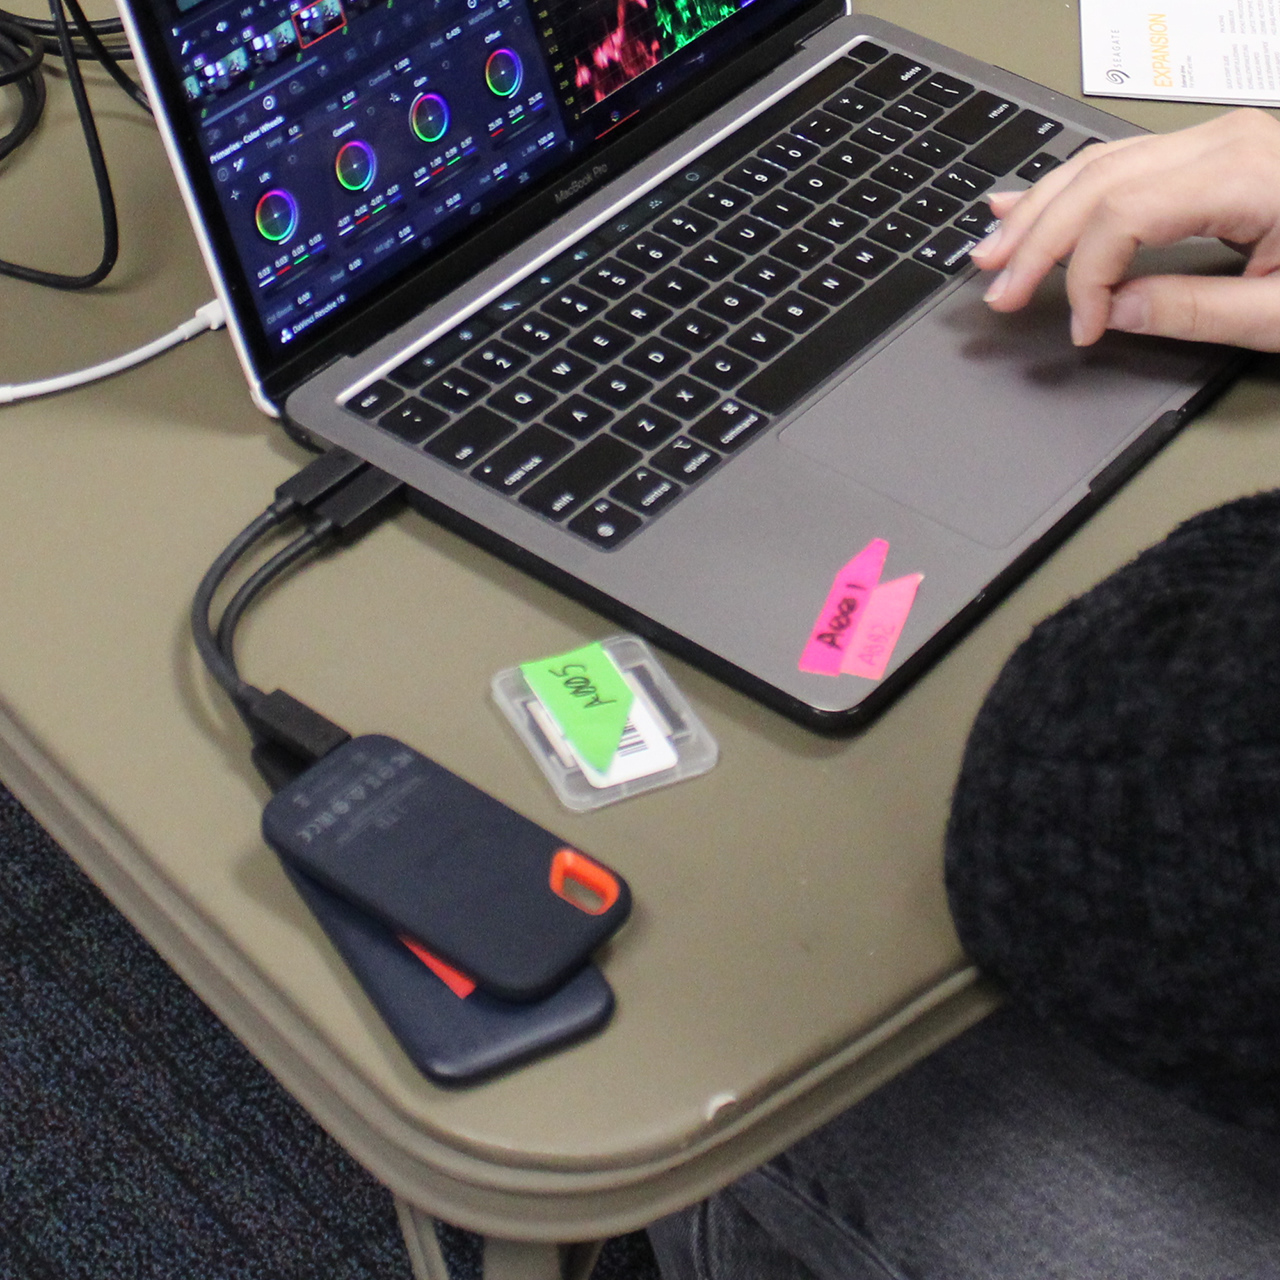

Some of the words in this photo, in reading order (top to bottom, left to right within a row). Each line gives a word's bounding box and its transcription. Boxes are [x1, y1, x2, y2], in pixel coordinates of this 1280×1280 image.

[484, 30, 501, 44] Offset
[1110, 29, 1122, 68] SEAGATE
[1147, 13, 1173, 87] EXPANSION
[900, 66, 922, 81] delete
[413, 76, 427, 88] Gain
[988, 103, 1009, 119] return
[332, 121, 355, 138] Gamma
[1037, 122, 1055, 135] shift
[209, 141, 242, 164] Primaries
[242, 129, 261, 144] Color
[258, 115, 284, 134] Wheels
[788, 149, 802, 158] 0
[841, 155, 853, 164] P
[554, 173, 592, 204] MacBook
[592, 163, 608, 178] Pro
[754, 174, 768, 183] 9
[808, 178, 824, 188] O
[720, 198, 735, 208] 8
[684, 223, 697, 233] 7
[828, 218, 844, 228] K
[739, 228, 755, 239] U
[797, 243, 809, 253] J
[944, 240, 977, 267] command
[649, 250, 663, 259] 6
[704, 254, 719, 264] Y
[856, 251, 874, 263] M
[758, 269, 776, 281] H
[611, 276, 626, 286] 5
[667, 281, 682, 291] T
[822, 278, 840, 290] N
[723, 297, 739, 307] G
[575, 303, 588, 313] 4
[787, 306, 804, 317] B
[292, 314, 315, 334] DaVinci
[313, 301, 338, 320] Resolve
[630, 309, 647, 319] R
[686, 324, 699, 335] F
[535, 331, 550, 341] 3
[593, 336, 609, 347] E
[751, 332, 767, 343] V
[648, 352, 665, 363] D
[496, 358, 511, 369] 2
[552, 362, 571, 375] W
[715, 361, 731, 372] C
[610, 381, 627, 392] S
[456, 388, 469, 397] 1
[676, 390, 694, 402] X
[361, 395, 378, 408] esc
[514, 393, 532, 404] Q
[572, 411, 588, 422] A
[638, 420, 656, 432] Z
[720, 413, 759, 444] command
[455, 447, 473, 460] tab
[683, 452, 711, 473] option
[504, 469, 526, 486] caps
[520, 457, 542, 472] lock
[641, 482, 671, 507] control
[552, 494, 574, 512] shift
[595, 503, 609, 513] fn
